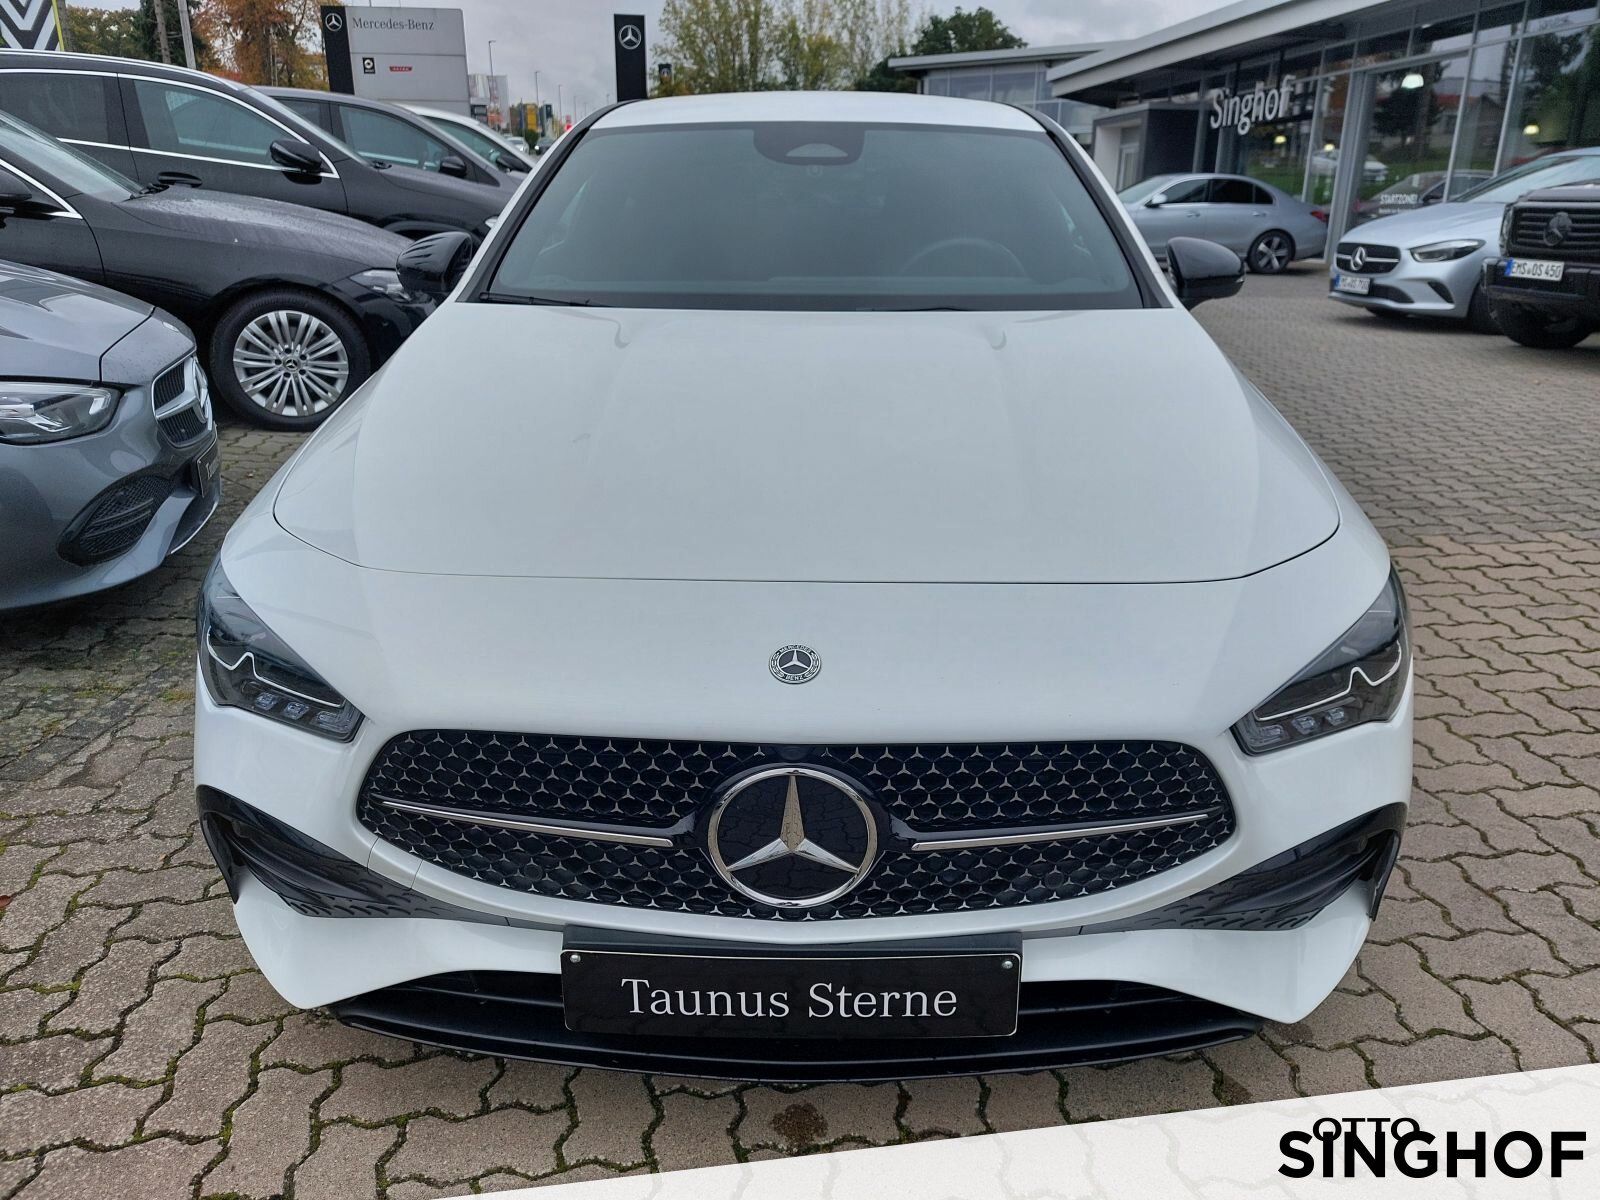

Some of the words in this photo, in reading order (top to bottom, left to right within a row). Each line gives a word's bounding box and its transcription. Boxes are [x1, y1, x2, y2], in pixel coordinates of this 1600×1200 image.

[352, 17, 435, 30] Mercedes-Benz
[1210, 74, 1296, 135] Singhof
[621, 978, 790, 1017] Taunus
[808, 982, 957, 1018] Sterne
